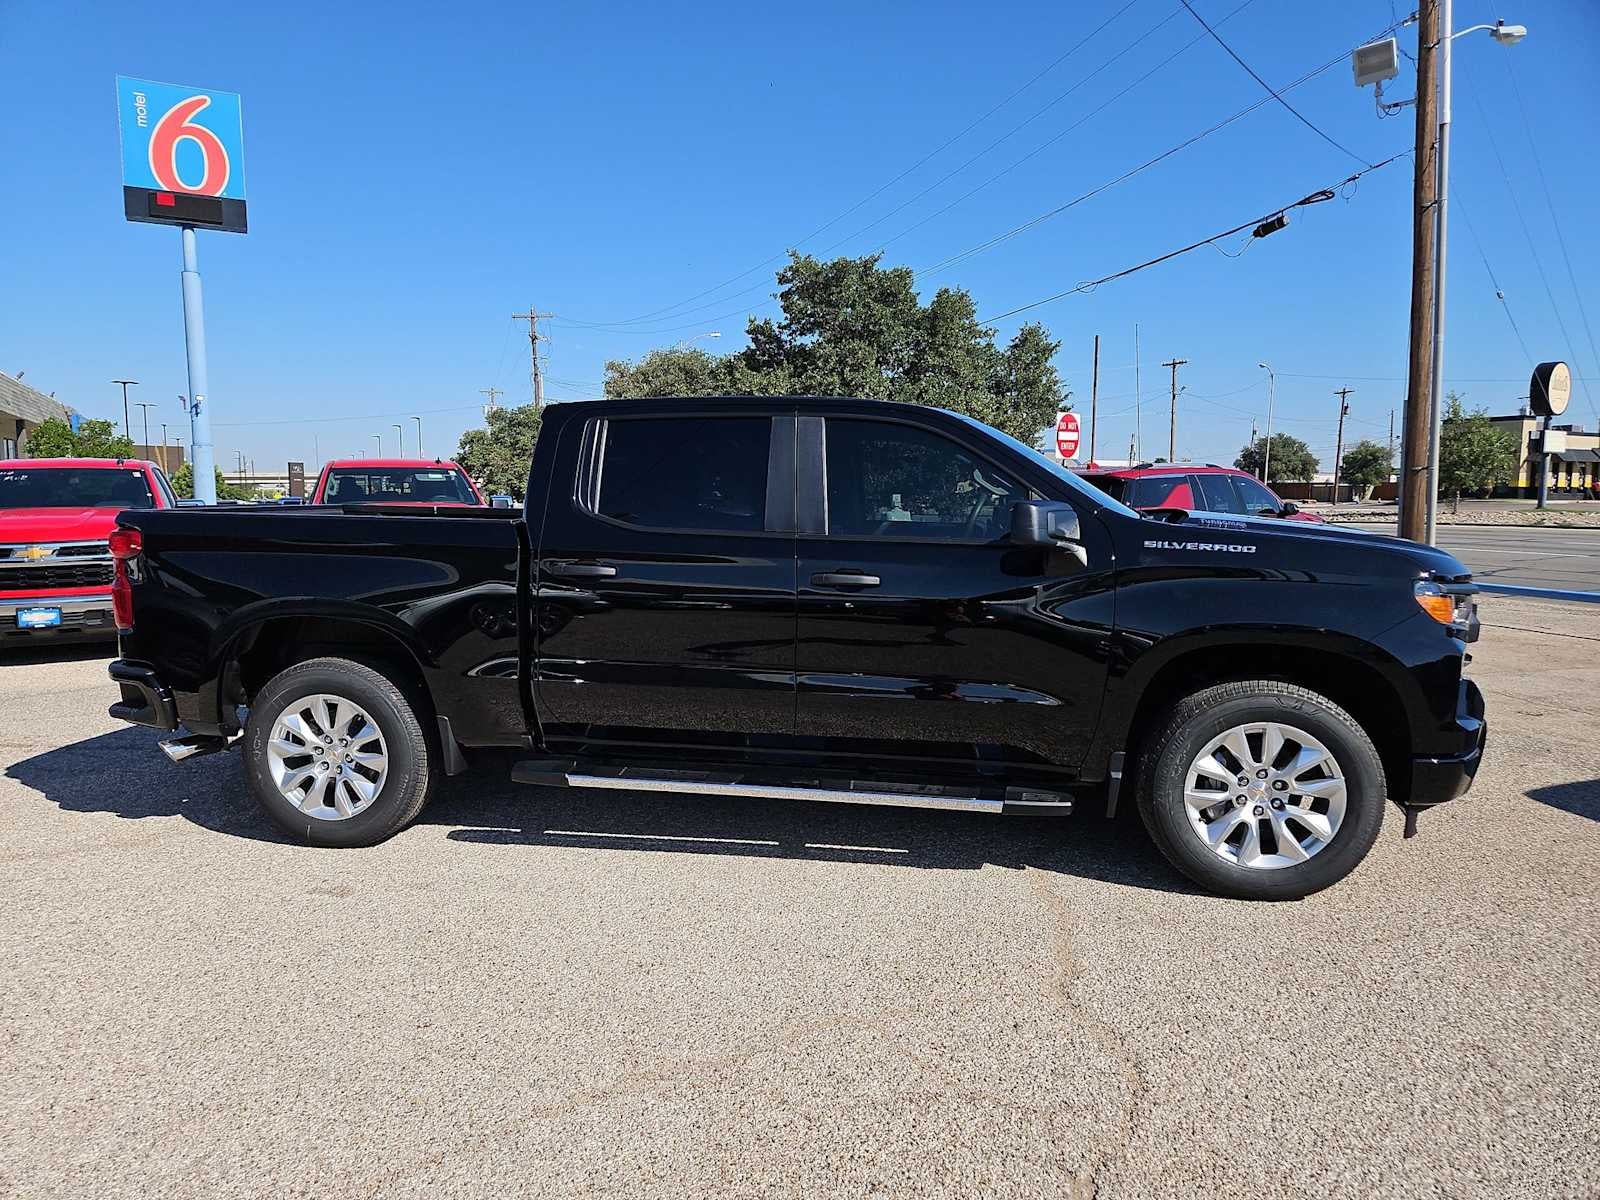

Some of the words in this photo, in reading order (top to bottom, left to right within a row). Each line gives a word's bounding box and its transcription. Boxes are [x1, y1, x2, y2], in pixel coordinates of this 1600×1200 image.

[133, 92, 147, 127] motel
[149, 95, 230, 197] 6
[1060, 422, 1067, 430] DO
[1068, 422, 1077, 430] NOT
[1061, 442, 1075, 450] ENTER
[1143, 540, 1257, 553] SILVERADO
